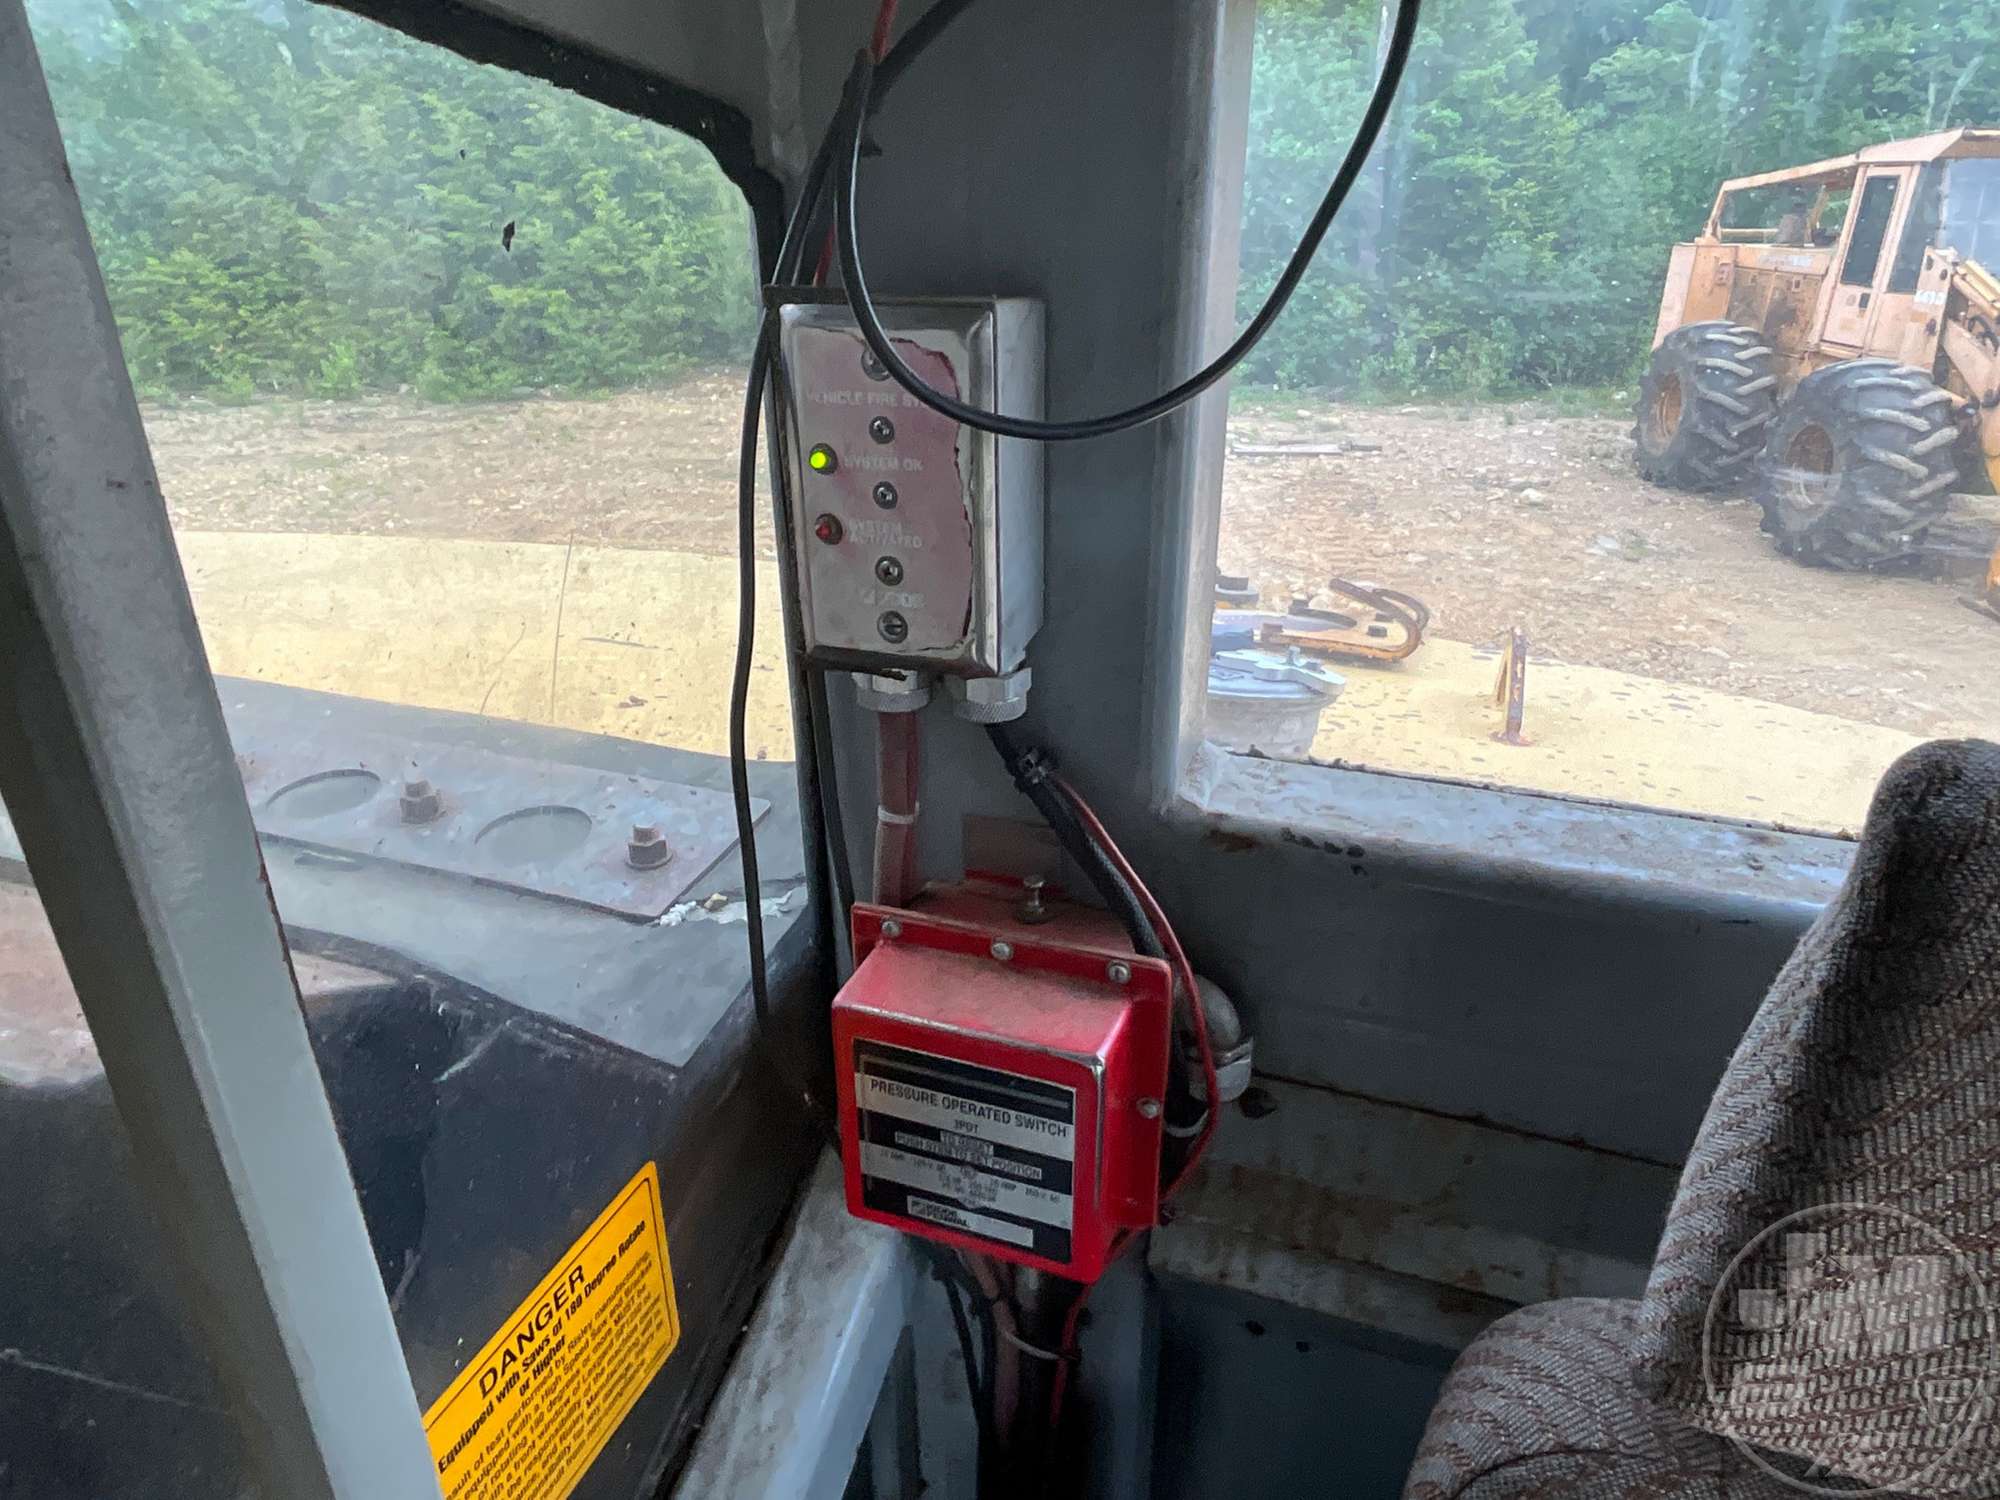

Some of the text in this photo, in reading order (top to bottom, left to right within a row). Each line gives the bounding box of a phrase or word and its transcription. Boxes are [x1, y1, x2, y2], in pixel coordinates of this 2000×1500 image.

[867, 392, 899, 407] FIRE
[844, 454, 923, 472] SYSTEM OK
[871, 1078, 1067, 1138] PRESSURE OPERATED SWITCH
[991, 1156, 1040, 1179] POSITION
[438, 1401, 494, 1473] Equipped
[495, 1371, 520, 1403] with
[521, 1334, 550, 1372] Saws
[551, 1316, 562, 1336] of
[583, 1254, 616, 1298] Degree
[618, 1220, 645, 1257] Rotate
[479, 1265, 585, 1397] DANGER
[473, 1452, 484, 1471] of
[485, 1428, 504, 1455] test
[506, 1366, 556, 1432] performed
[554, 1353, 565, 1369] by
[567, 1320, 592, 1353] Risley
[518, 1335, 565, 1396] or Higher
[463, 1437, 510, 1500] equipped
[511, 1412, 531, 1439] with
[540, 1374, 562, 1403] High
[562, 1338, 589, 1375] Speed
[590, 1318, 607, 1340] Saw
[513, 1439, 536, 1471] front
[537, 1396, 570, 1440] window
[489, 1435, 527, 1484] rotating
